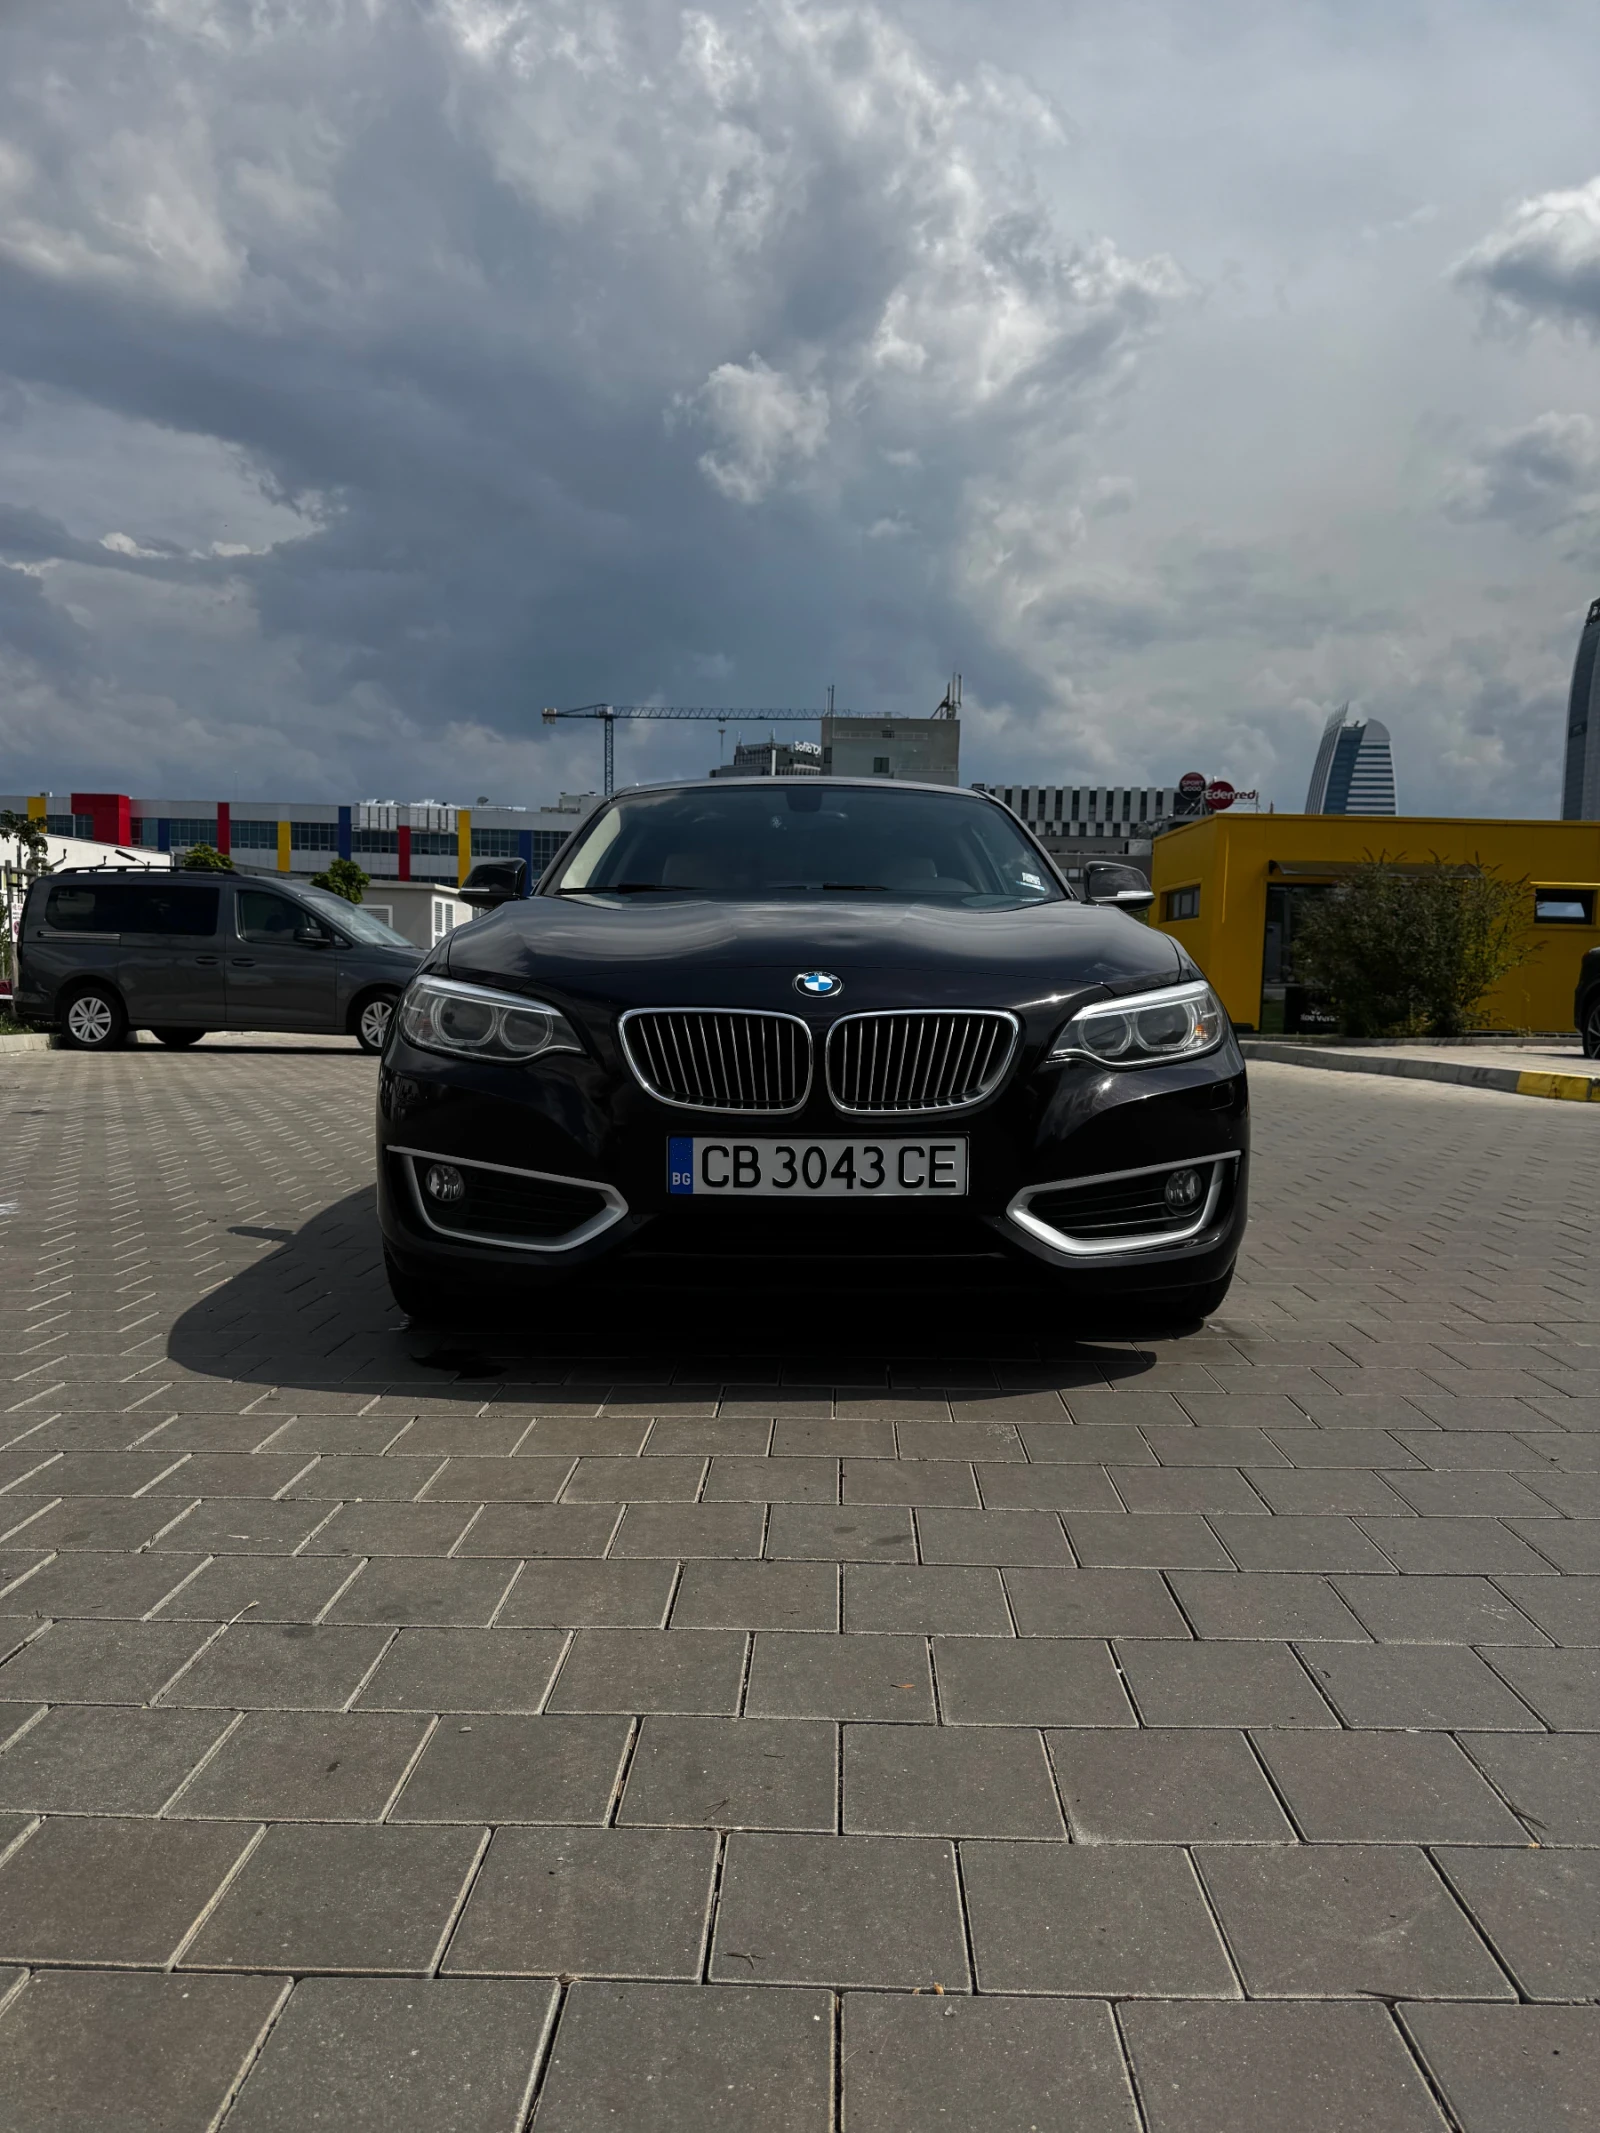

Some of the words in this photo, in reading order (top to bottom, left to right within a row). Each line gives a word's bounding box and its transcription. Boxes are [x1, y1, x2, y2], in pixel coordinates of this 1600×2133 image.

[1205, 789, 1256, 800] Edenred
[701, 1145, 762, 1189] CB
[772, 1145, 886, 1190] 3043
[898, 1145, 957, 1189] CE
[671, 1171, 691, 1186] BG
